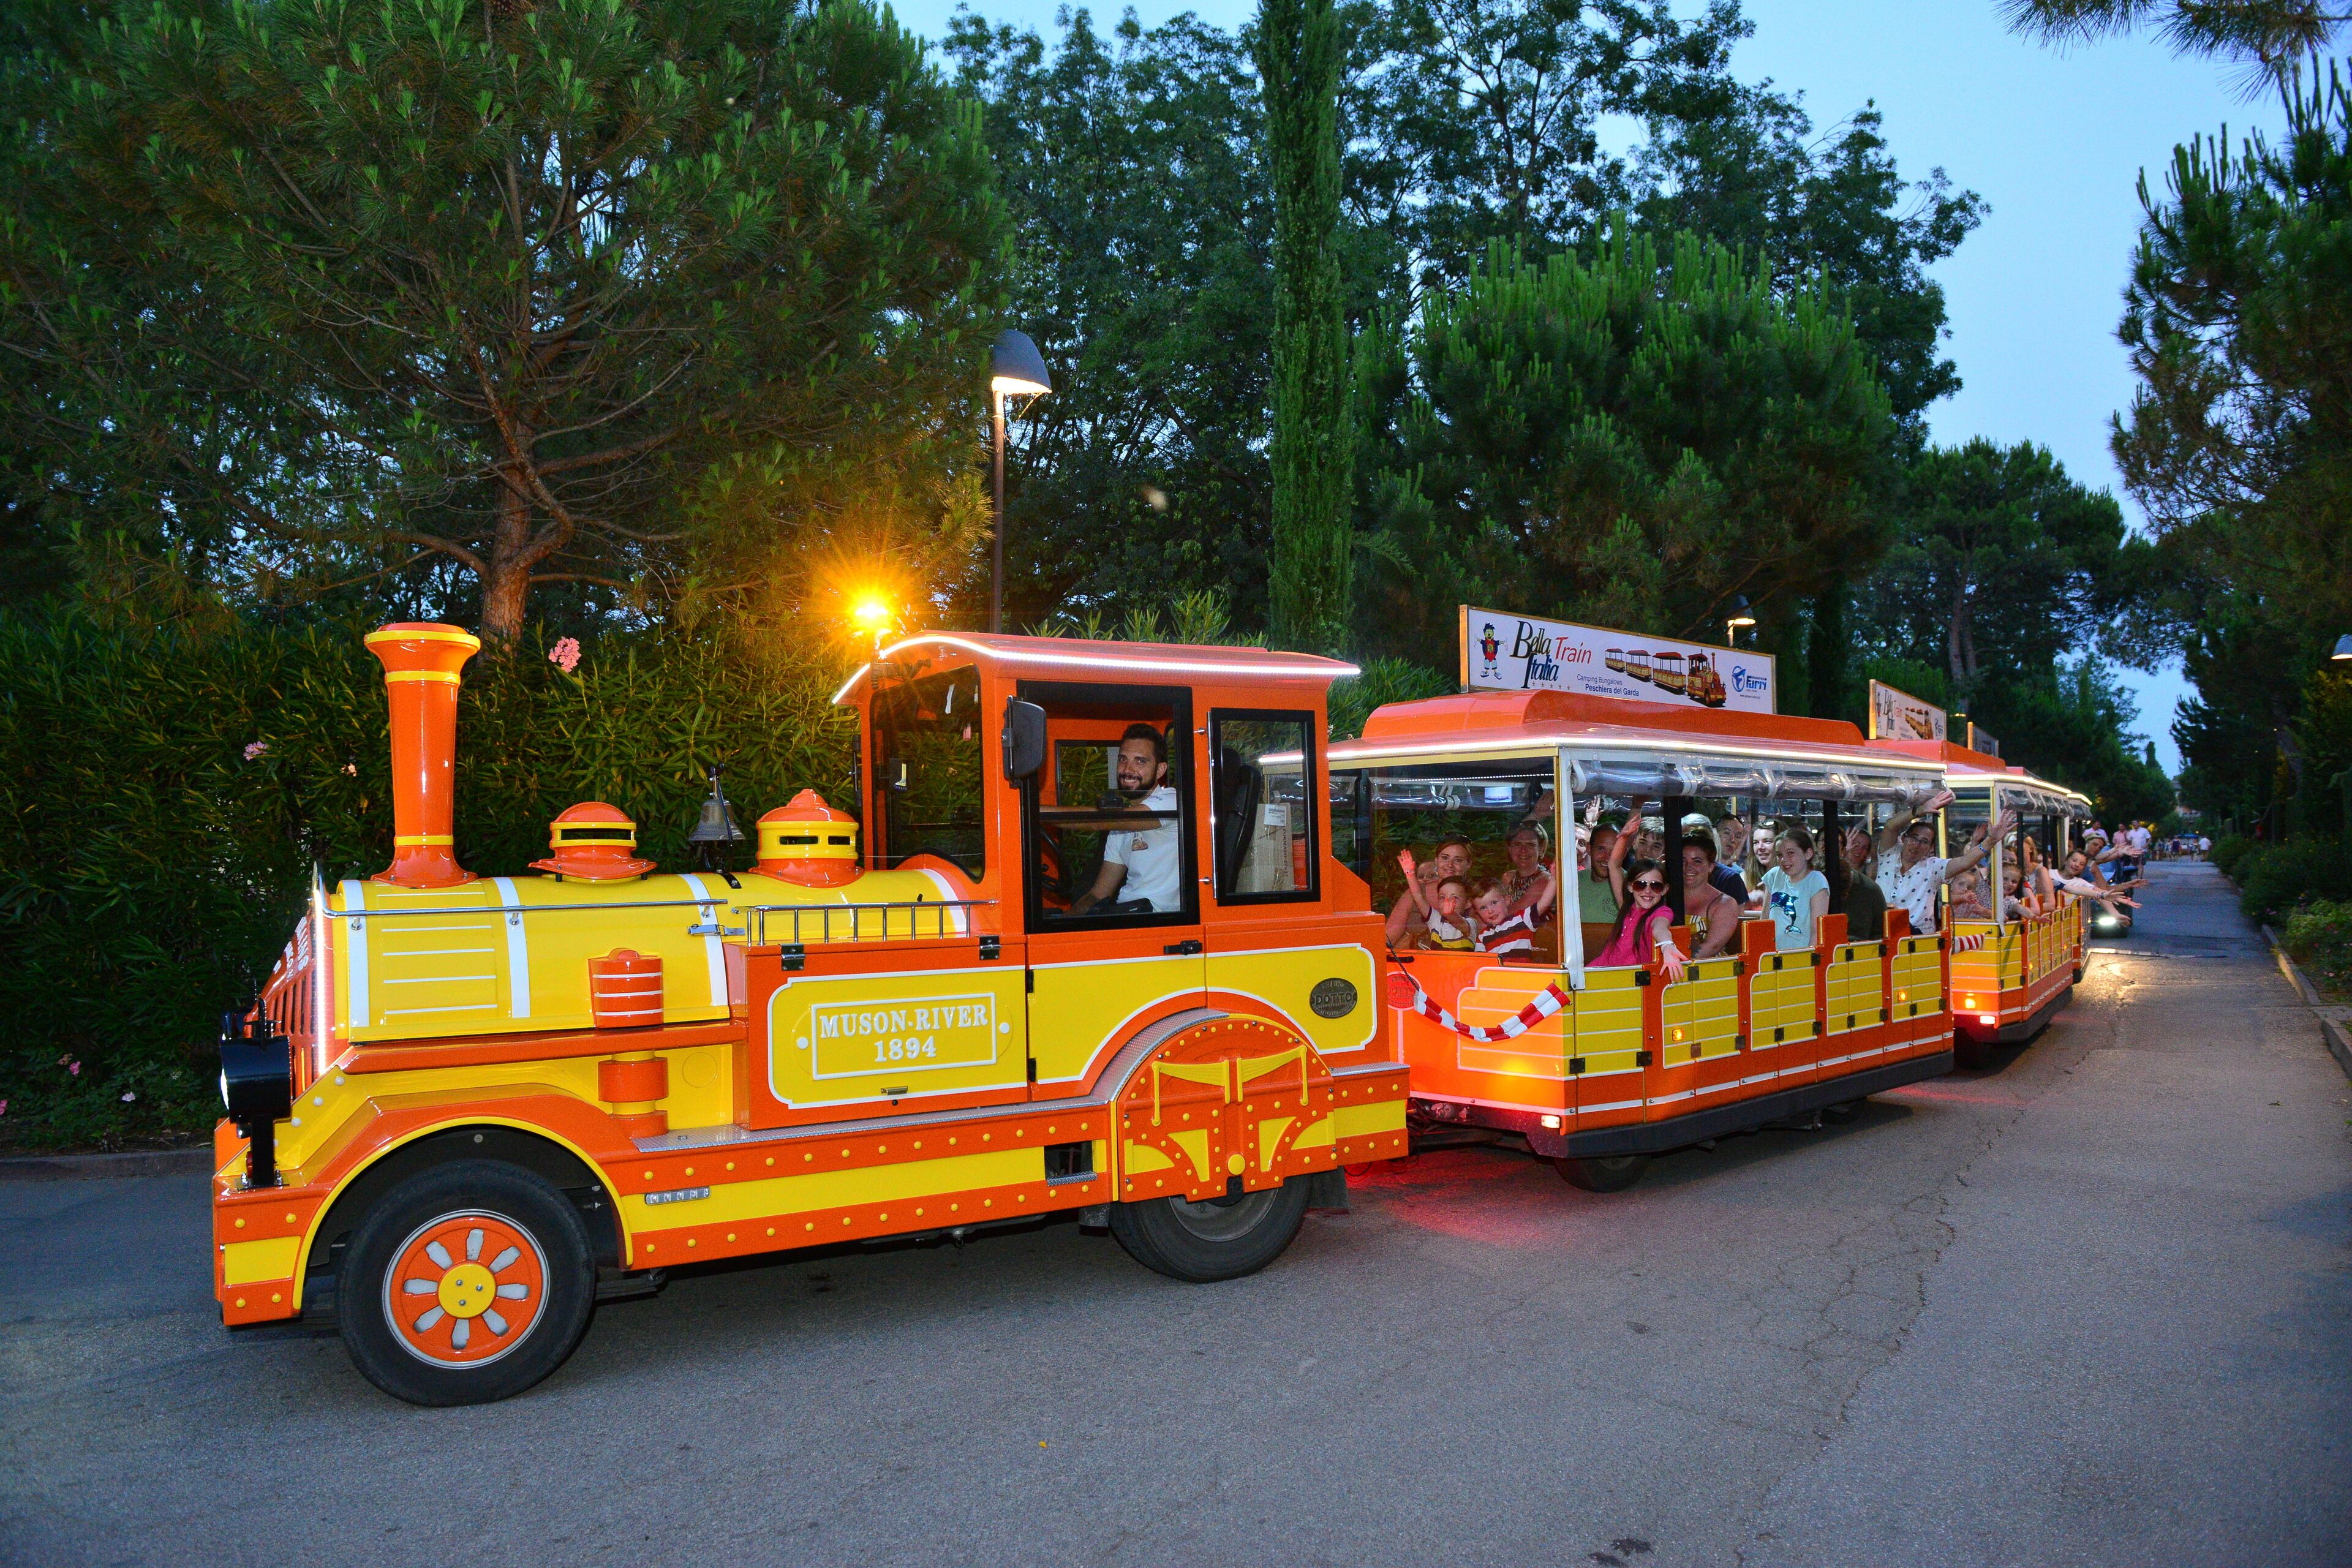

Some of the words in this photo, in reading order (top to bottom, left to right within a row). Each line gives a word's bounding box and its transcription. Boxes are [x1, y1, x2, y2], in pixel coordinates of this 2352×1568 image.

[1509, 620, 1551, 658] Bella
[1555, 637, 1591, 664] Train
[1521, 653, 1559, 688] Italia
[1577, 674, 1597, 684] Camping
[1599, 677, 1622, 685] Bungalows
[1585, 684, 1612, 693] Peschiera
[1623, 688, 1639, 696] Garda
[1315, 992, 1352, 1005] DOTTO
[875, 1036, 937, 1062] 1894
